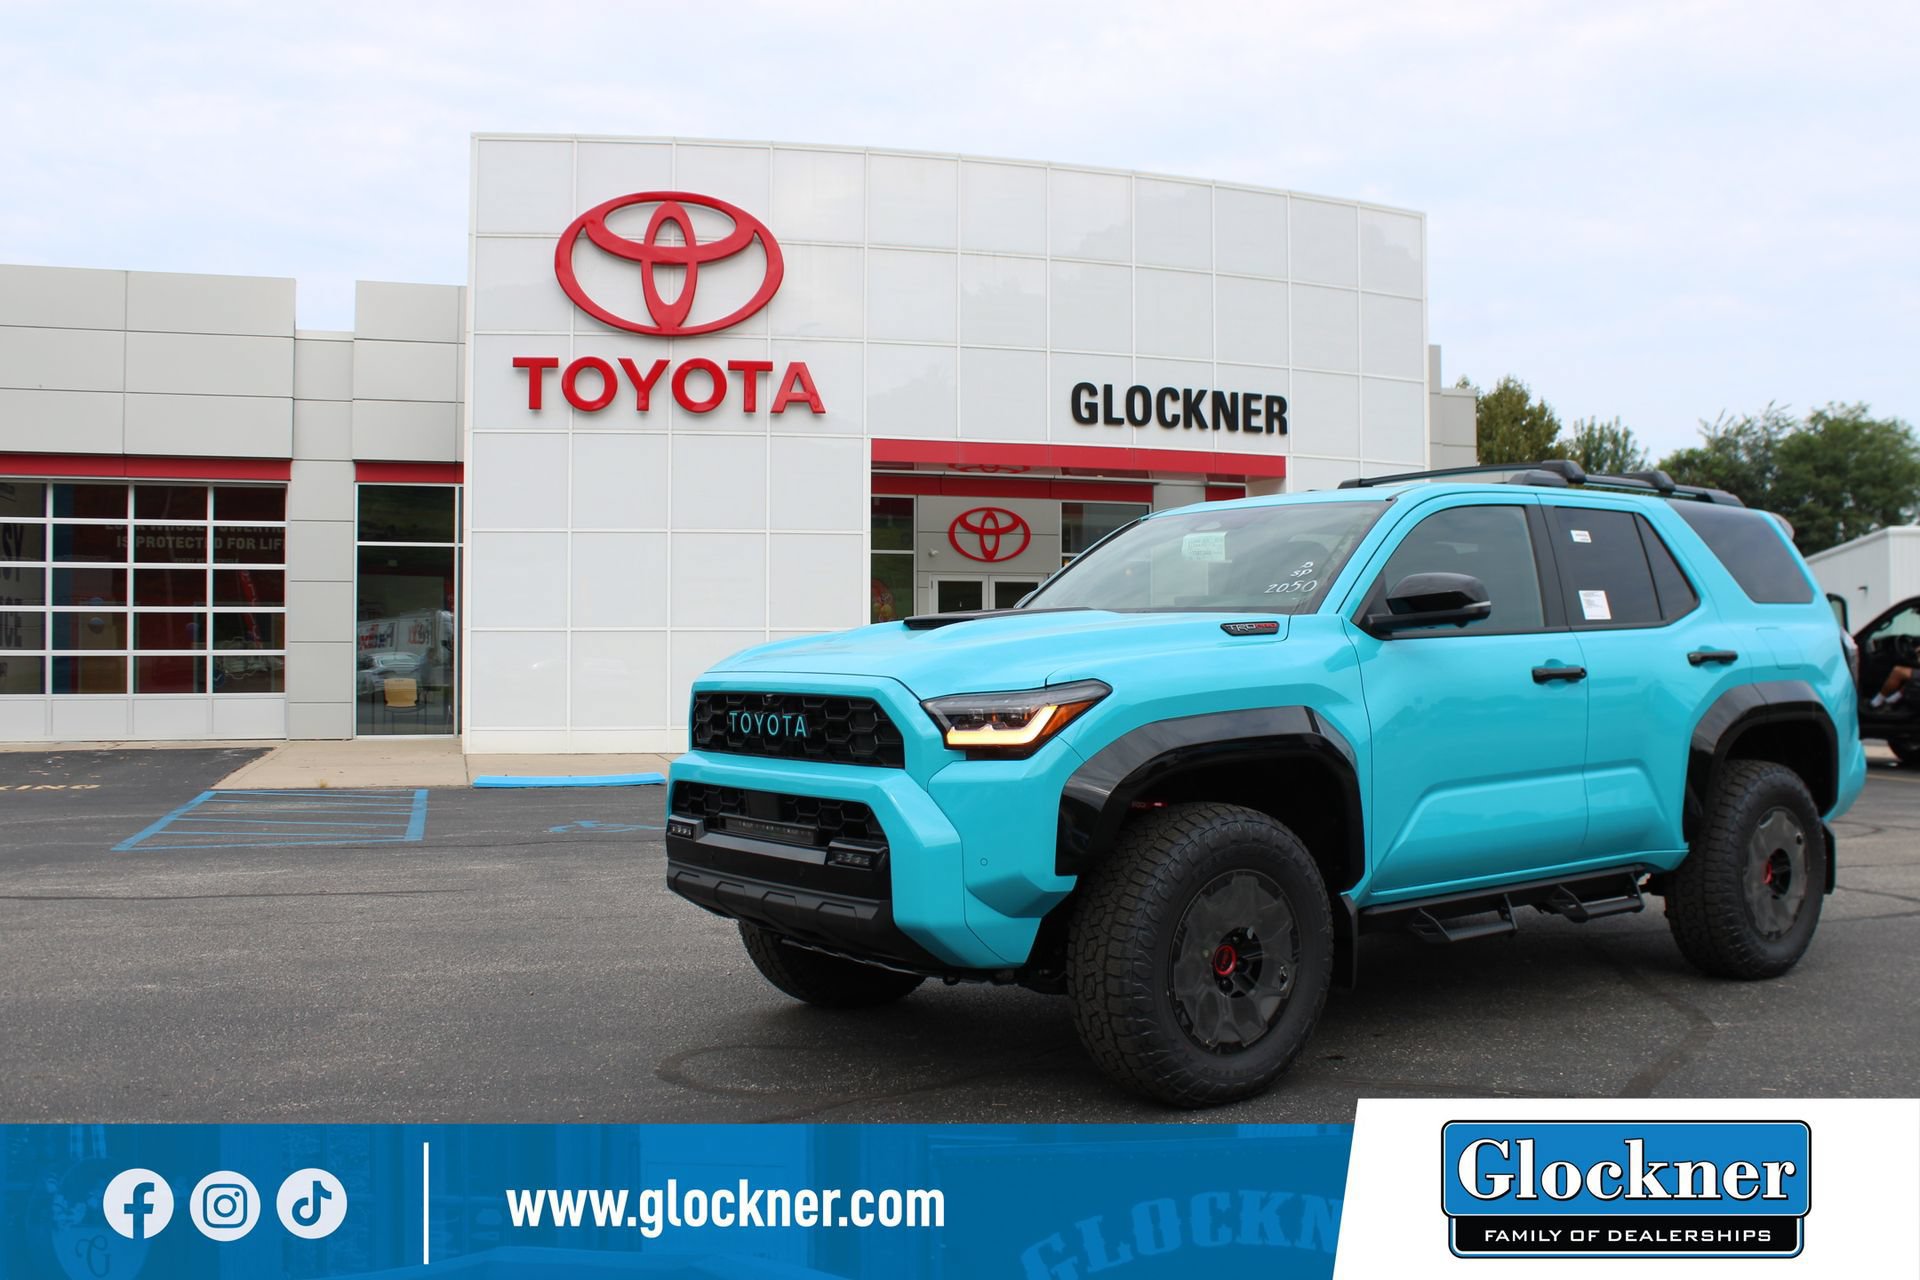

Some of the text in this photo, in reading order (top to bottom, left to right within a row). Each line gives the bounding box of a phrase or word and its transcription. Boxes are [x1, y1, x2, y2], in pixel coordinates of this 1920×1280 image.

[512, 356, 826, 414] TOYOTA
[1071, 381, 1289, 435] GLOCKNER
[135, 535, 223, 550] PROTECTD
[227, 537, 256, 551] FOR
[259, 538, 285, 551] LIF
[1263, 579, 1319, 594] 2050
[729, 712, 807, 738] TOYOTA
